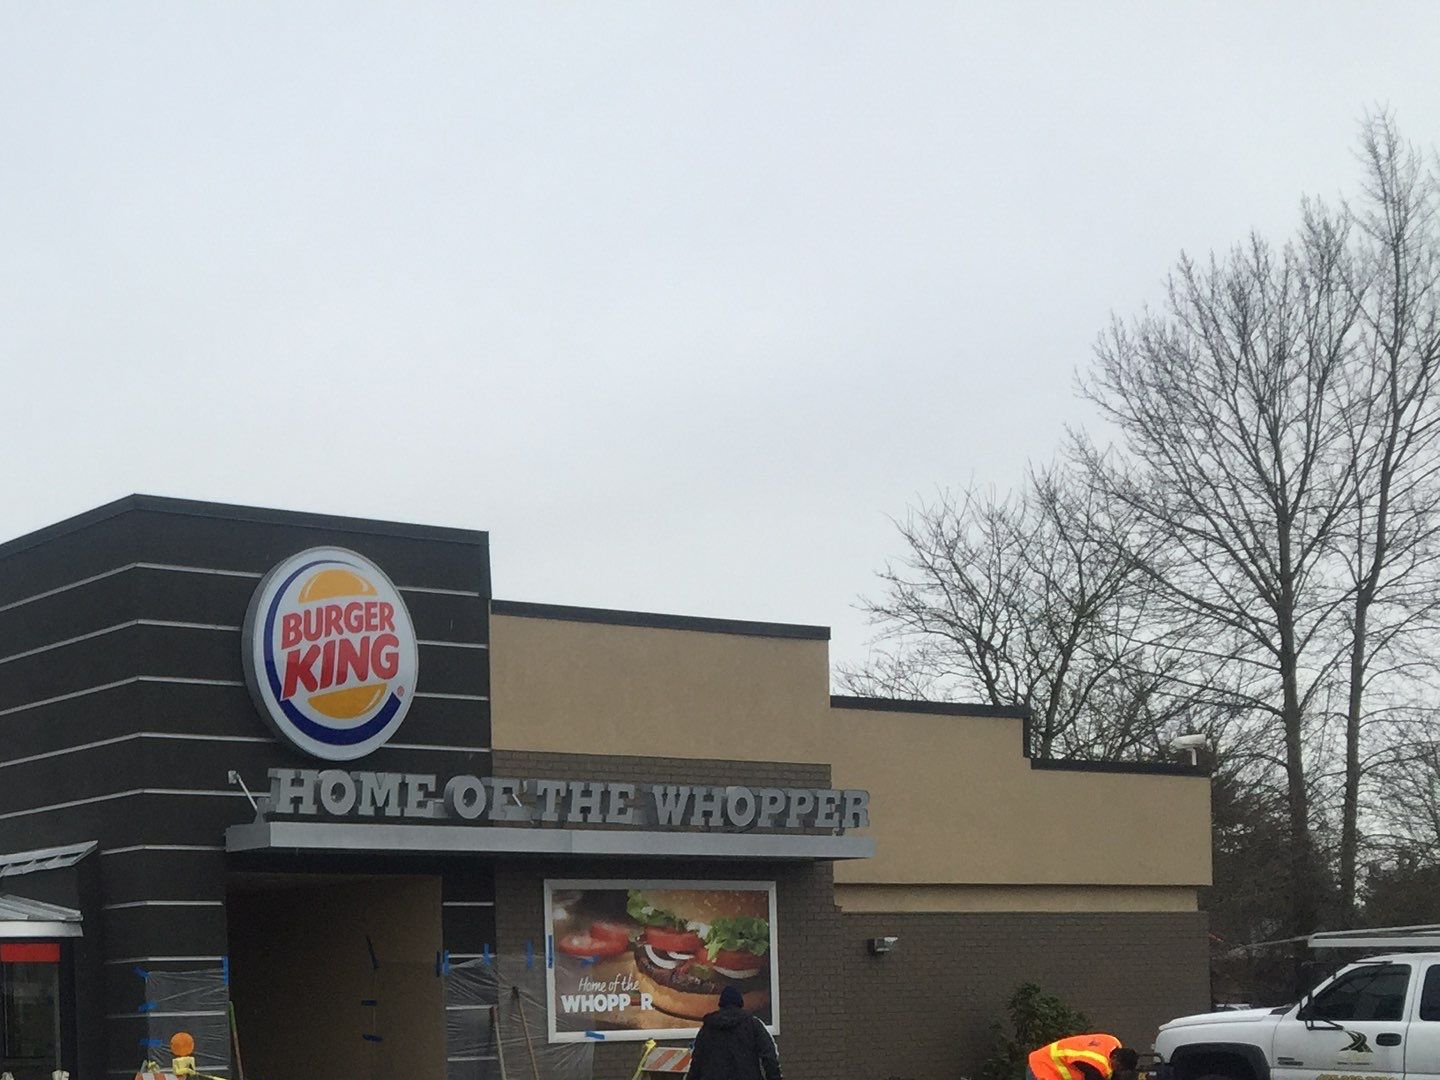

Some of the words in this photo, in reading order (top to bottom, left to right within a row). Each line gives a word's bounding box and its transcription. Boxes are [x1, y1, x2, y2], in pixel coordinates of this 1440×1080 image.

[281, 601, 396, 650] BURGER
[282, 633, 400, 699] KING
[268, 768, 436, 818] HOME
[443, 775, 518, 820] OF
[528, 778, 635, 824] THE
[647, 785, 871, 828] WHOPPER
[561, 992, 654, 1013] WHOPPR
[578, 976, 607, 992] Home
[608, 973, 621, 994] of
[621, 972, 640, 991] the
